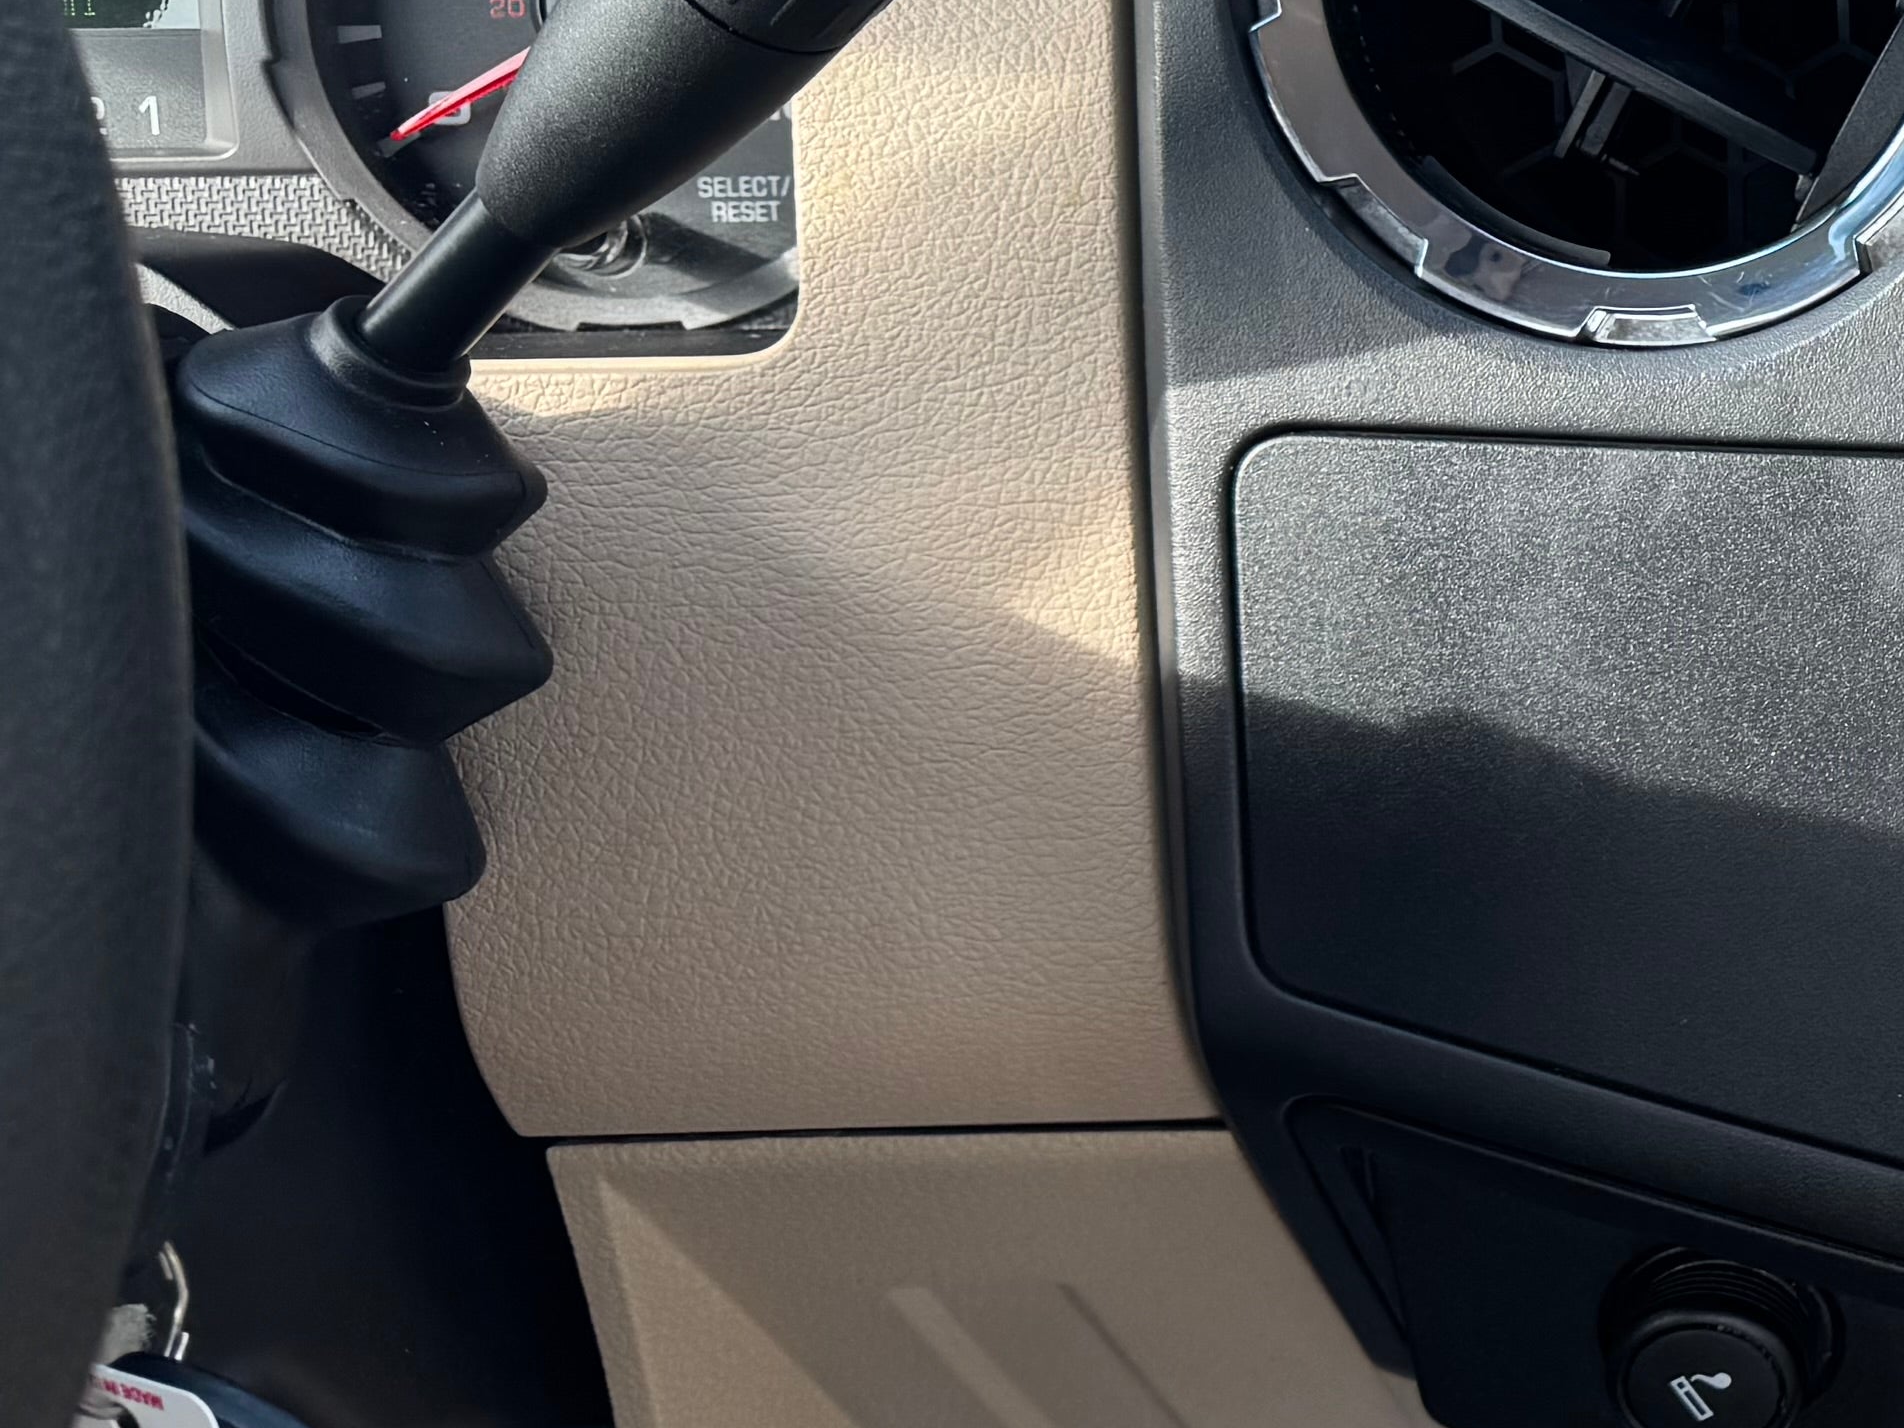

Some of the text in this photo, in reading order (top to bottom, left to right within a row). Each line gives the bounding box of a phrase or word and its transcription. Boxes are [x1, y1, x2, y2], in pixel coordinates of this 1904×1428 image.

[138, 96, 160, 136] 1
[697, 176, 791, 198] SELECT/
[712, 201, 779, 222] RESET
